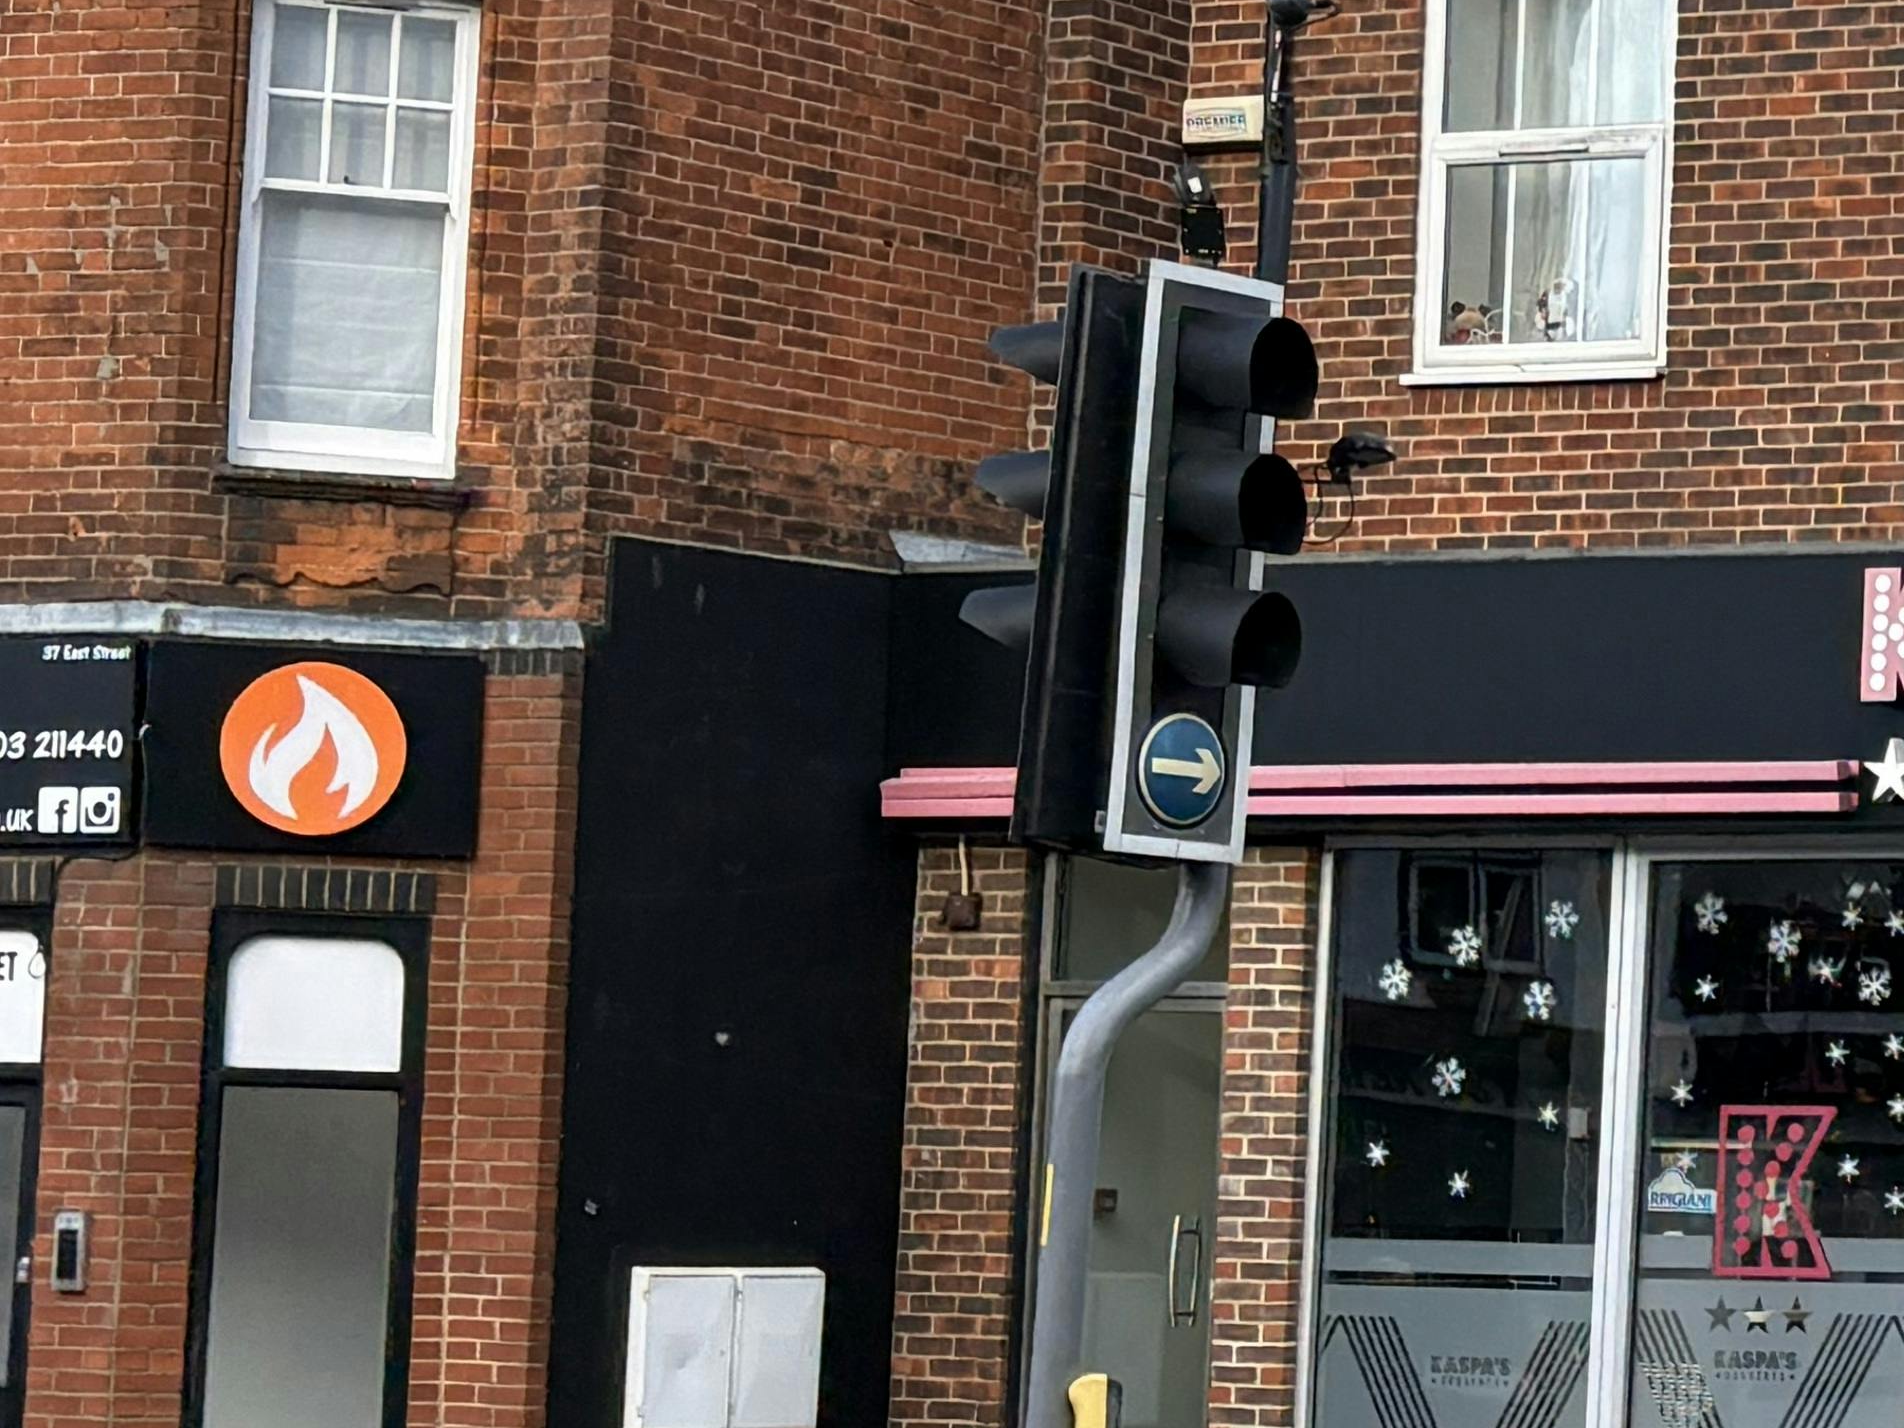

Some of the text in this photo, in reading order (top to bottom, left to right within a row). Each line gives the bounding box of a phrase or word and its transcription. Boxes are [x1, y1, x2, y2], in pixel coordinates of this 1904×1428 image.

[63, 644, 90, 660] East
[92, 645, 131, 660] Street
[33, 729, 123, 759] 211440
[0, 808, 34, 832] .UK
[1714, 1350, 1797, 1370] KASPA'S
